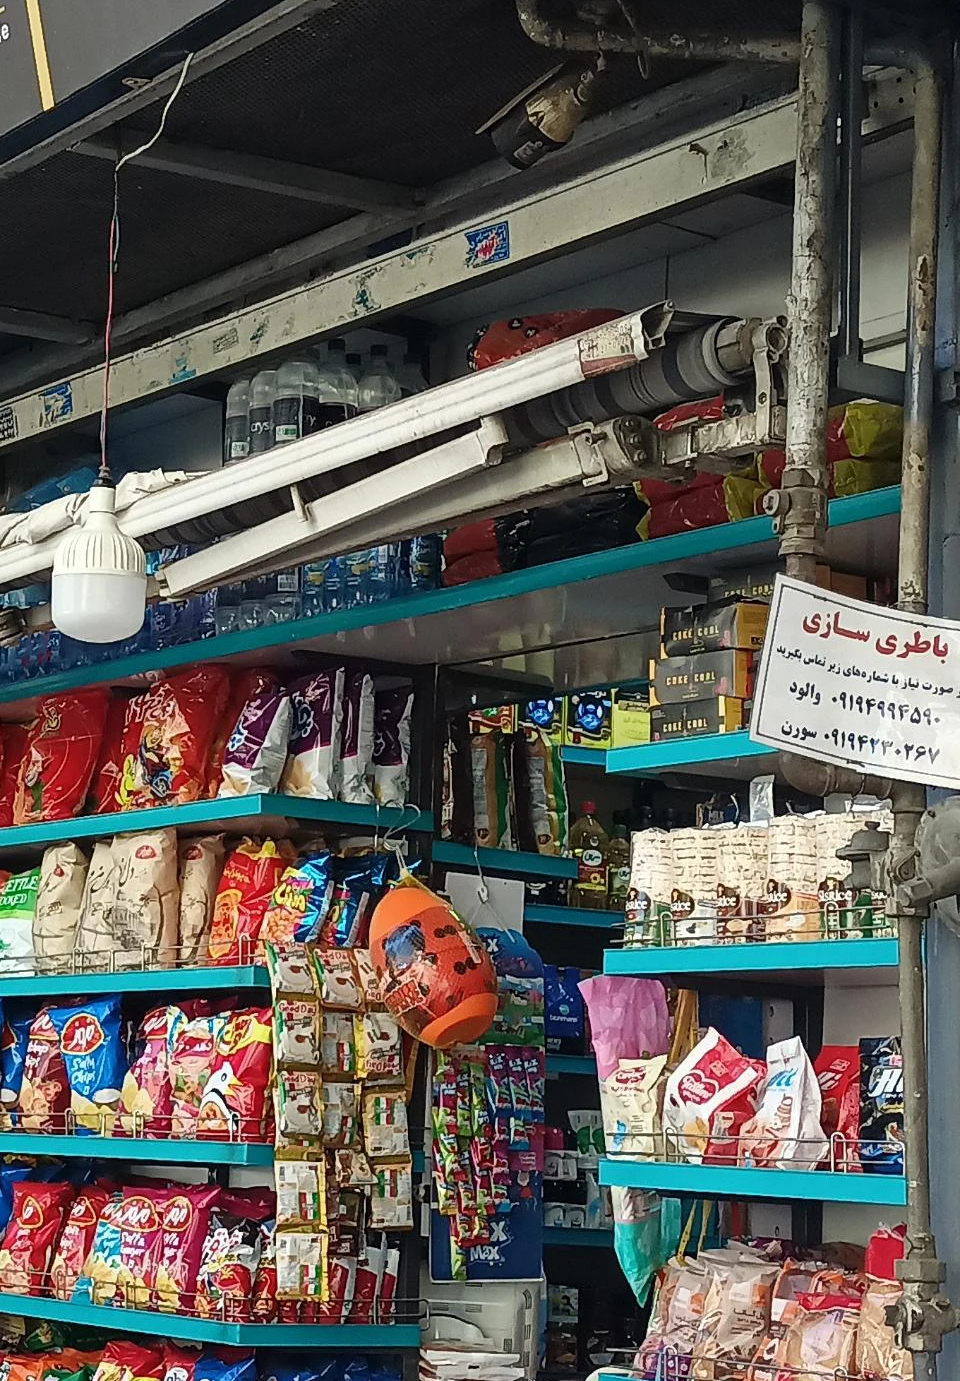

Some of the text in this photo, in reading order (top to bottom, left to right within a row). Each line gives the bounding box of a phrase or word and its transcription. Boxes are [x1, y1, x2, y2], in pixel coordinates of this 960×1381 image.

[802, 610, 949, 664] باطری سازی
[776, 643, 803, 662] بگیرید
[803, 654, 827, 669] تماس
[827, 660, 842, 674] زیر
[891, 673, 900, 687] با
[902, 674, 920, 690] نیاز
[921, 680, 954, 696] صورت
